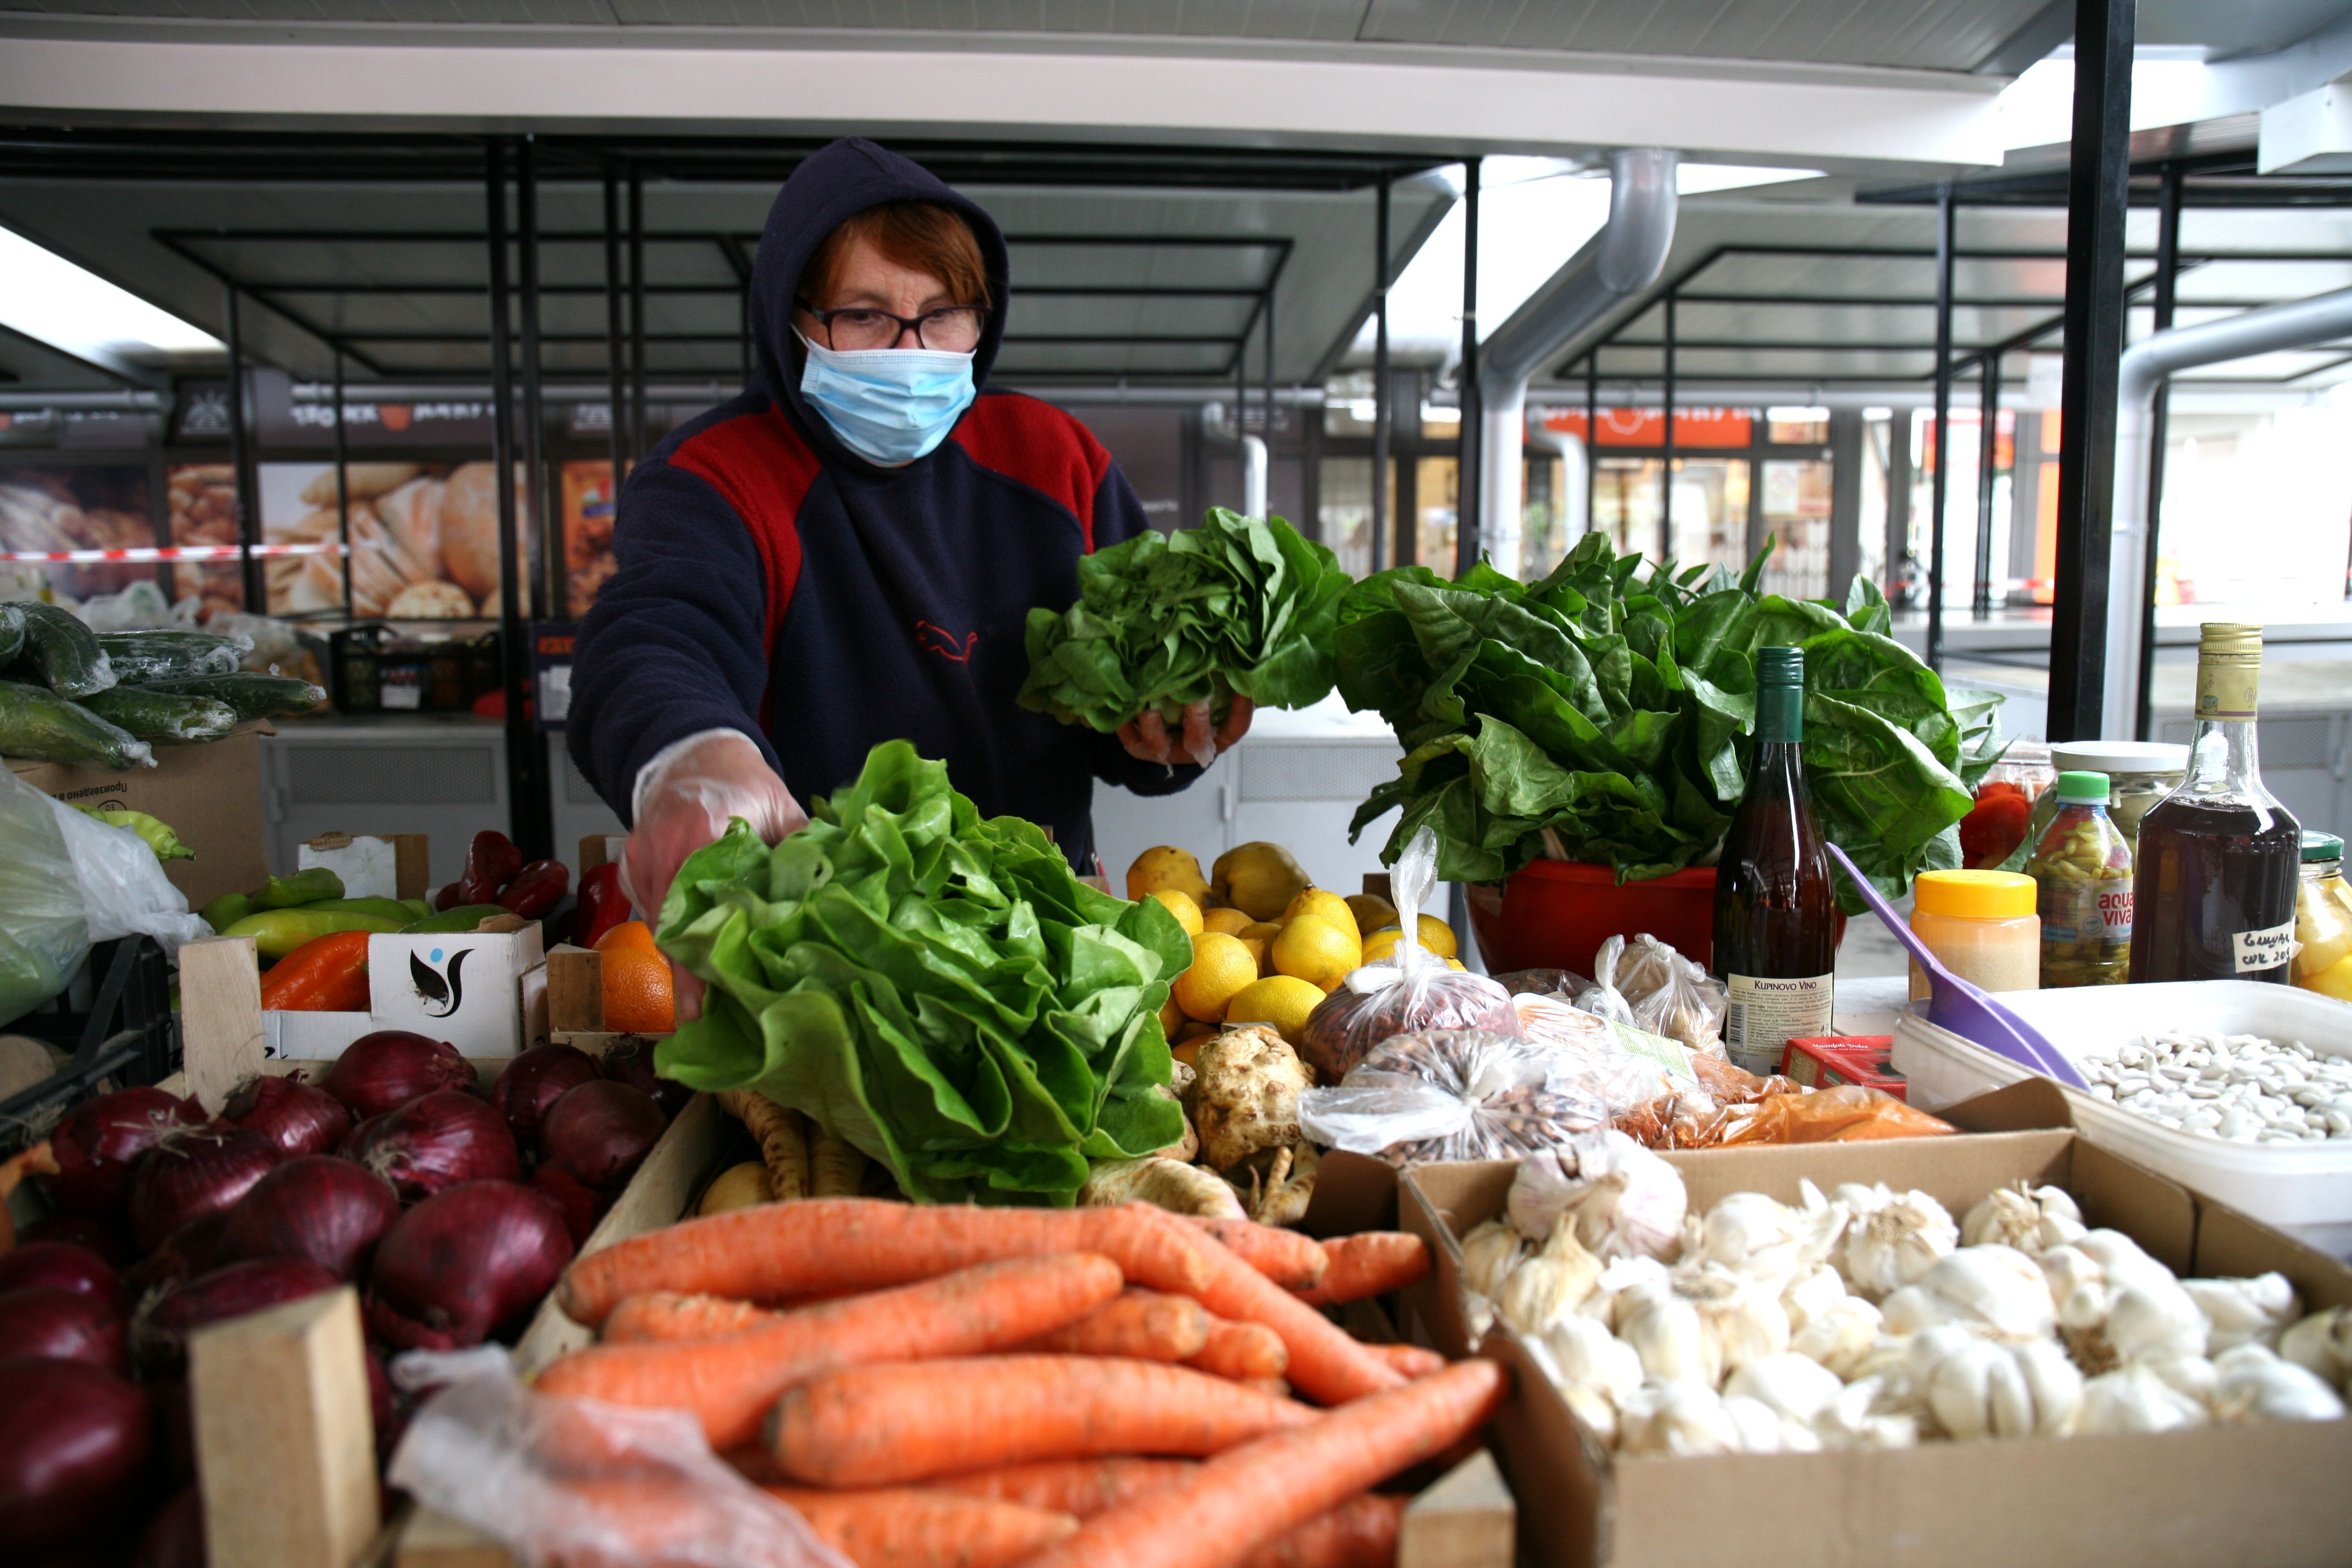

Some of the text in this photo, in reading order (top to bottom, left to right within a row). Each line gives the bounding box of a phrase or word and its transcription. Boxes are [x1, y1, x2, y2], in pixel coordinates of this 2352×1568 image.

[67, 781, 127, 800] Произведено
[2098, 892, 2134, 909] aqua
[2103, 909, 2131, 926] viva
[1754, 981, 1817, 991] KUPINOVO VINO
